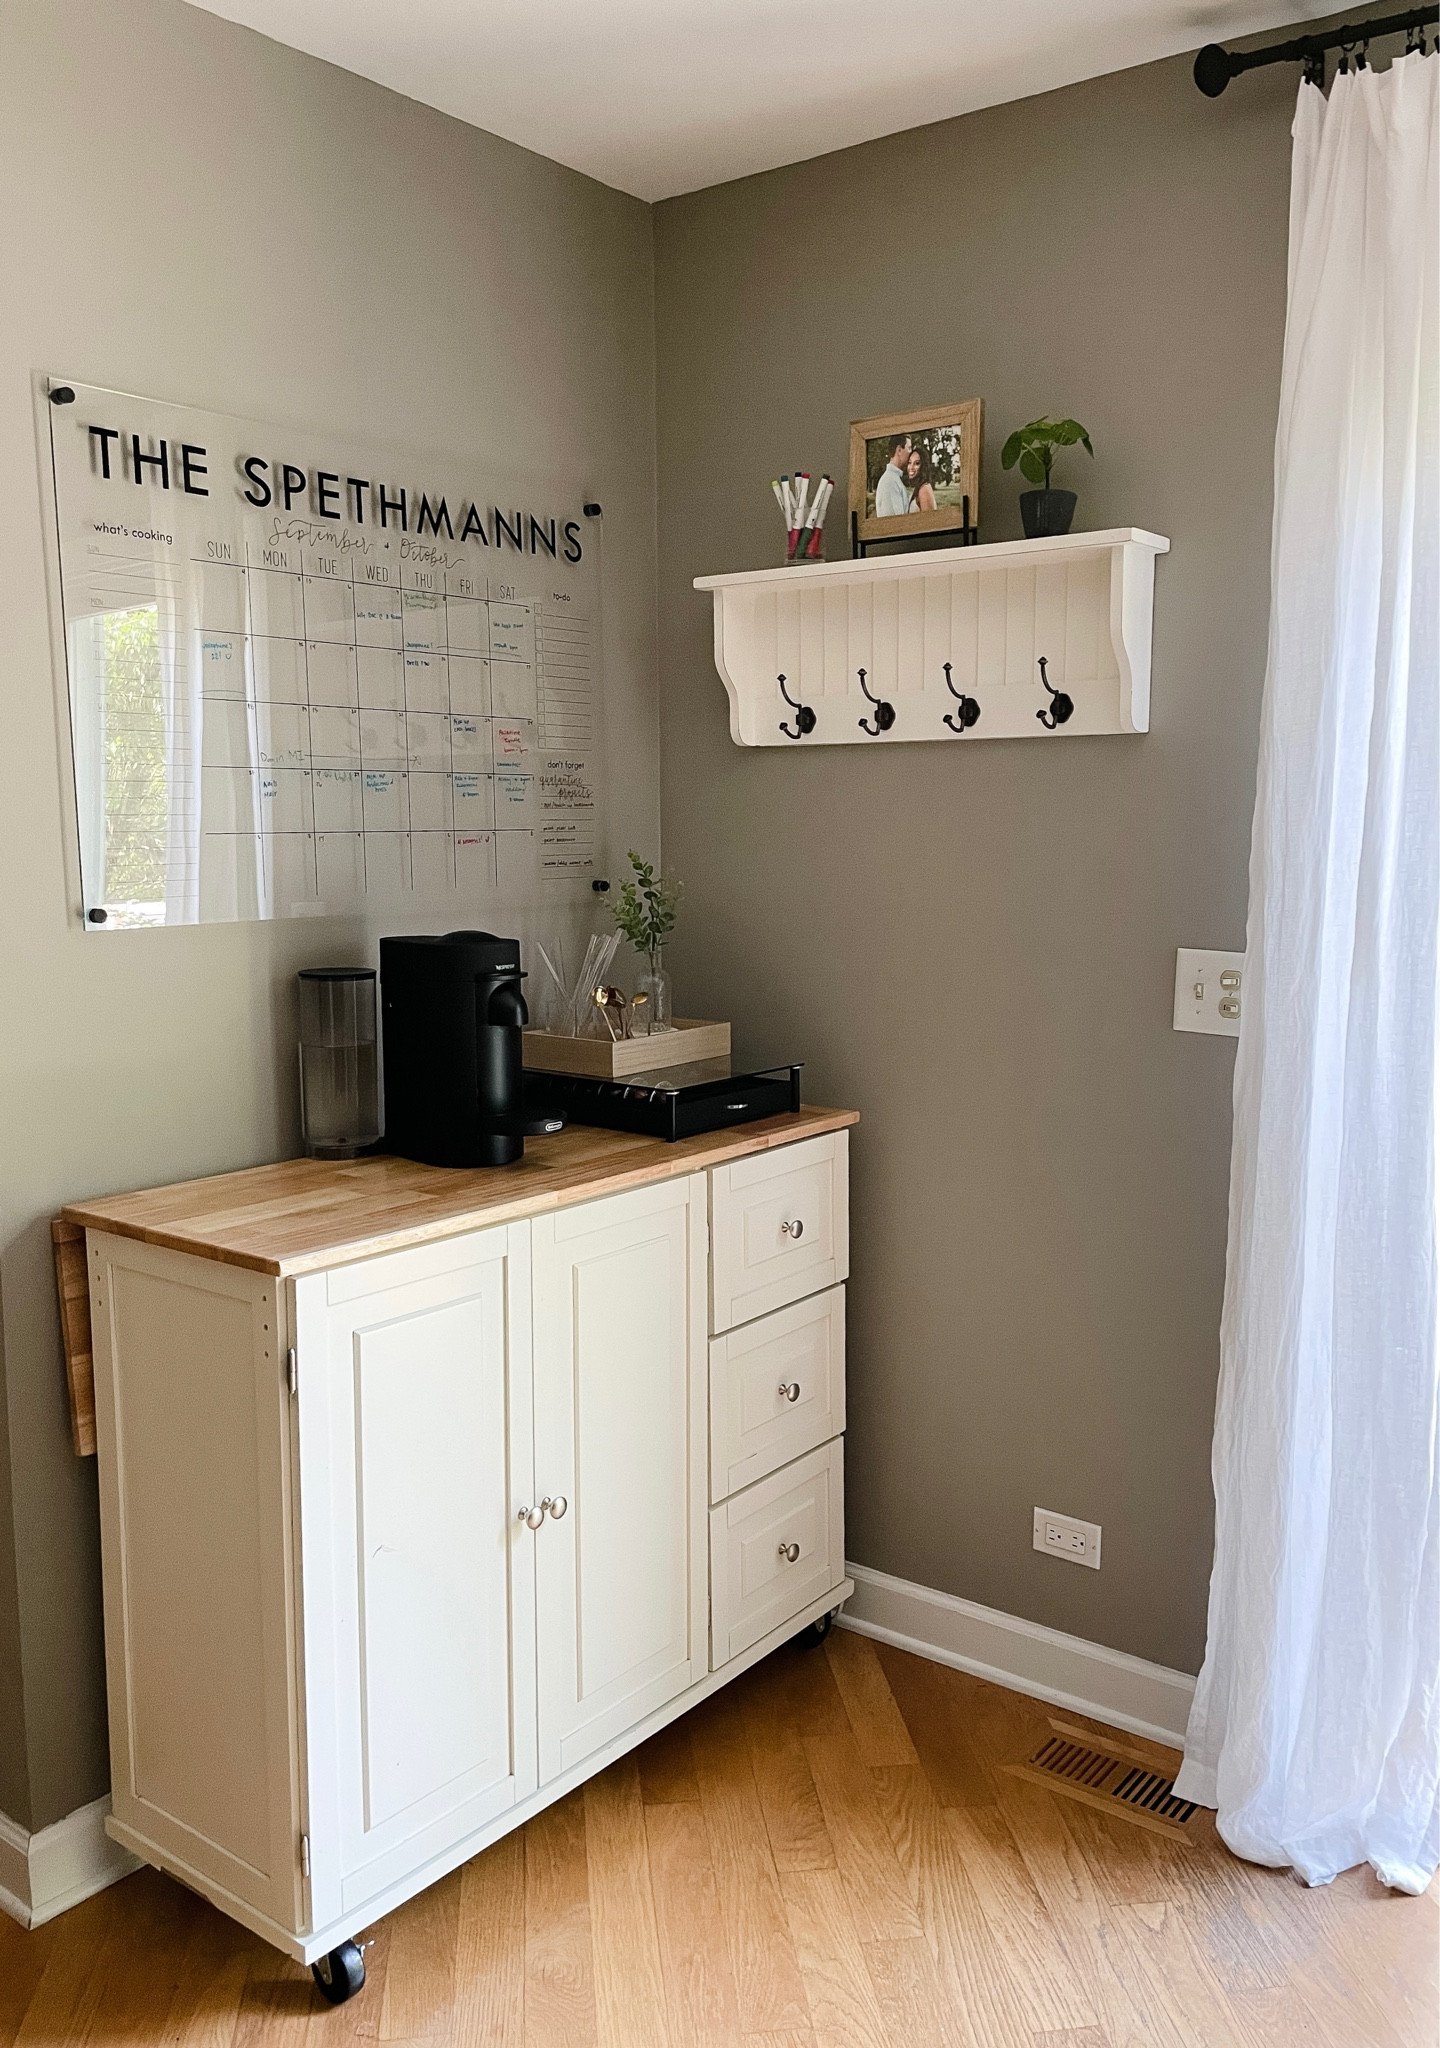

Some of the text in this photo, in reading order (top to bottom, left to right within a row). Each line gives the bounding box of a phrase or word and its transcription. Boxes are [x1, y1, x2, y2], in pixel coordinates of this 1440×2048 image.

[88, 425, 583, 563] THE SPETHMANNS
[93, 522, 173, 545] what's cooking
[268, 517, 375, 554] September
[399, 538, 466, 569] October
[207, 541, 515, 600] SUN MON TUE WED THU FRI SAT
[552, 591, 571, 602] to-do
[547, 760, 585, 771] don't forget
